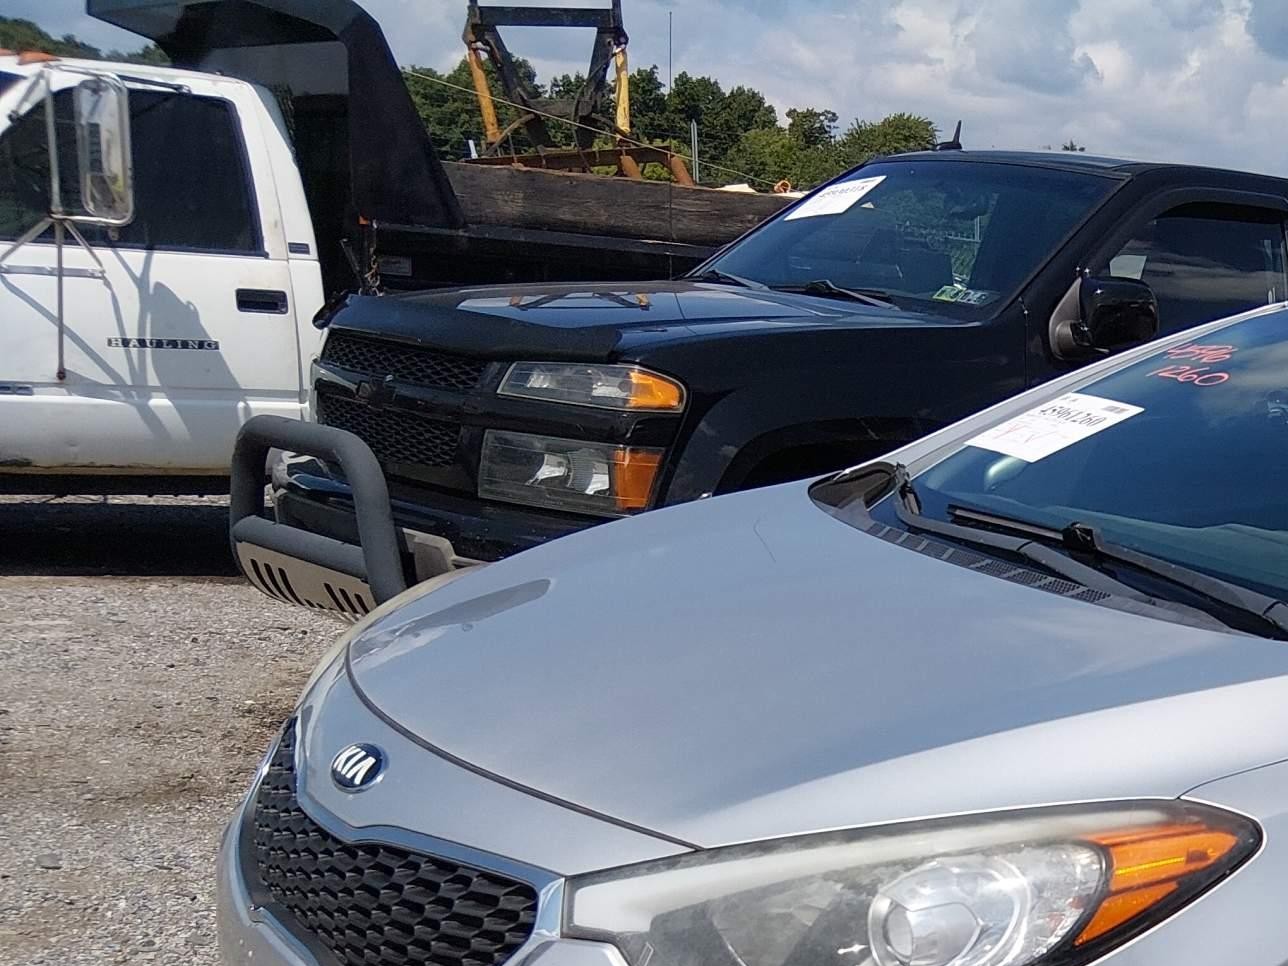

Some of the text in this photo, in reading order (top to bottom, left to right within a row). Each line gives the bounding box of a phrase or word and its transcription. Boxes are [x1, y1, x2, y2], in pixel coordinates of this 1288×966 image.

[108, 338, 219, 350] HAULING
[1145, 365, 1230, 386] 1260
[333, 745, 377, 785] KIA
